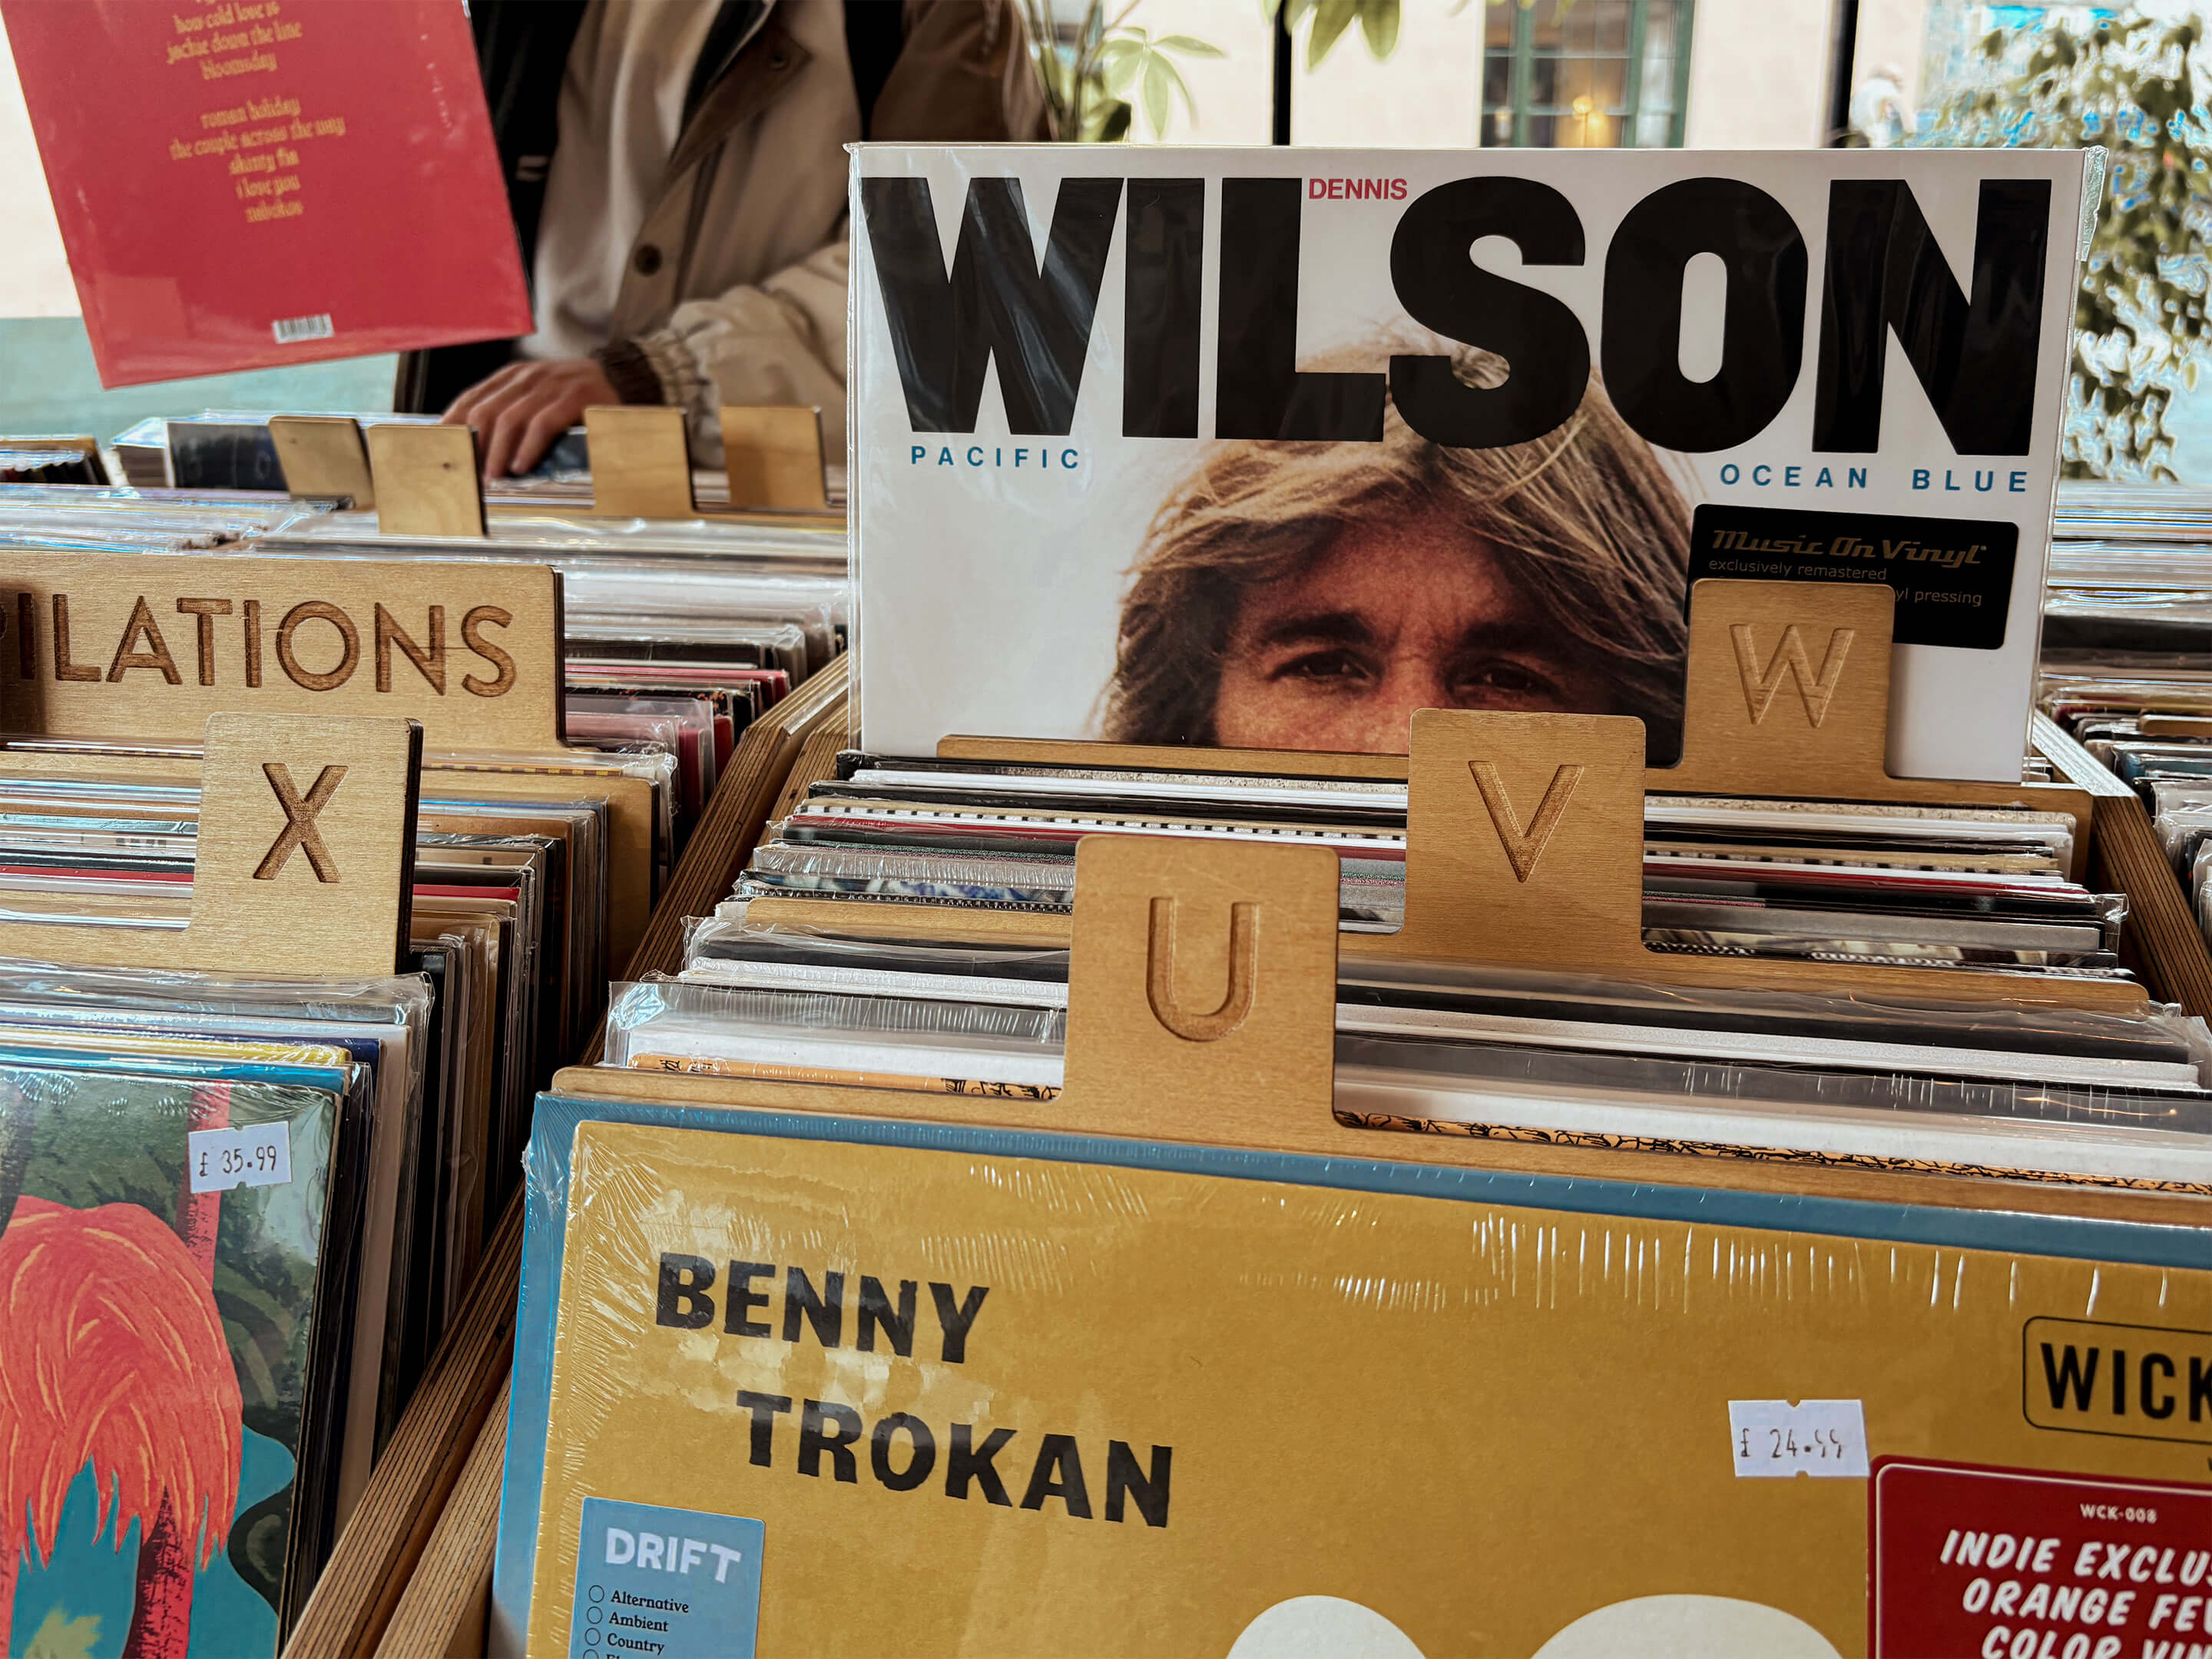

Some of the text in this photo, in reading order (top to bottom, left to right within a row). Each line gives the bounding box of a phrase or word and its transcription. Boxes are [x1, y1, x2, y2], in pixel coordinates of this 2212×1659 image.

[1309, 178, 1407, 200] DENNIS
[861, 177, 2052, 462] WILSON
[911, 445, 1078, 469] PACIFIC
[1720, 463, 2027, 492] OCEAN BLUE
[1711, 530, 1982, 568] Music On Vinyl
[1708, 558, 1887, 581] exclusively remastered
[1915, 588, 1983, 607] pressing
[0, 592, 516, 697] ILATIONS
[1728, 624, 1856, 729] W
[253, 763, 349, 883] X
[1468, 760, 1585, 882] V
[1146, 896, 1260, 1042] U
[199, 1145, 277, 1177] £ 35.99
[655, 1252, 989, 1364] BENNY
[736, 1389, 1173, 1528] TROKAN
[1740, 1428, 1751, 1458] £
[2080, 1503, 2157, 1524] WCK-008
[605, 1526, 742, 1584] DRIFT
[1940, 1529, 2212, 1587] INDIE EXCLU
[611, 1589, 689, 1613] Alternative
[1962, 1577, 2136, 1626] ORANGE
[608, 1611, 669, 1632] Ambient
[607, 1633, 665, 1656] Country
